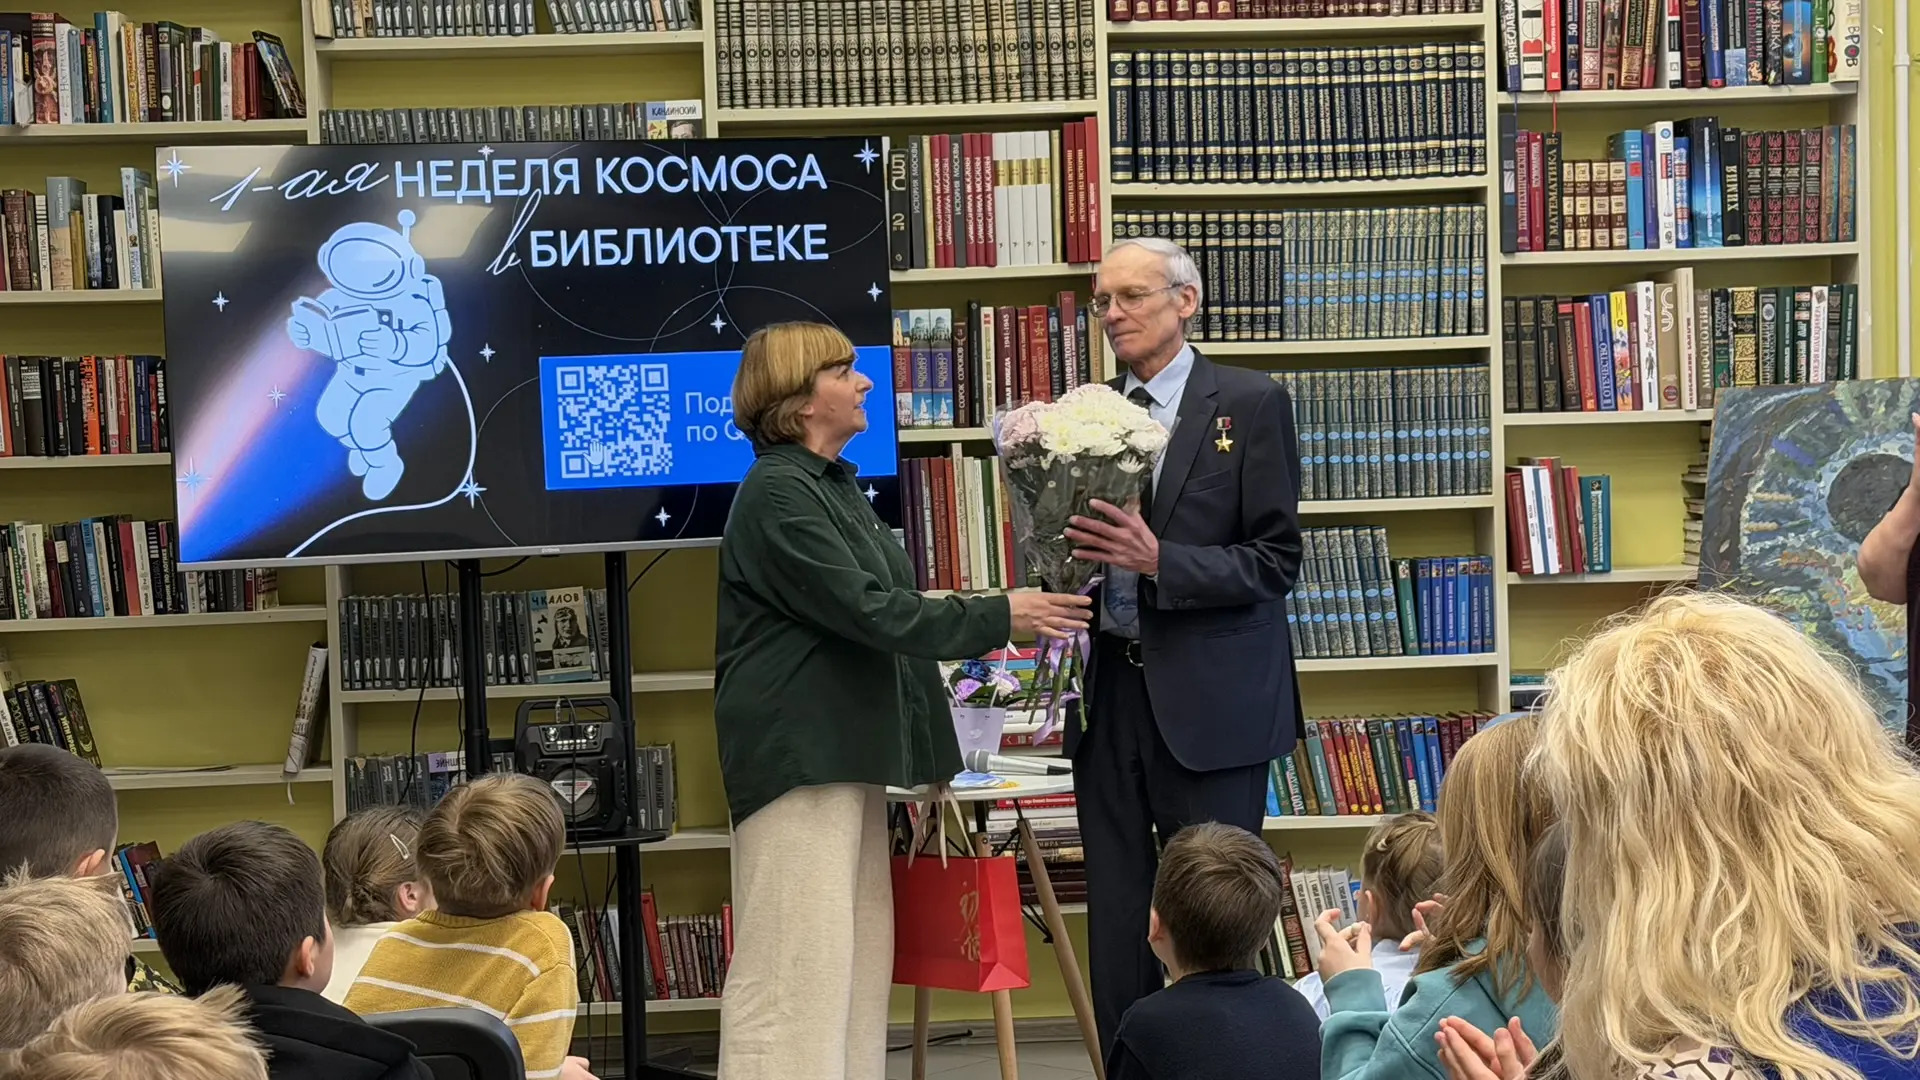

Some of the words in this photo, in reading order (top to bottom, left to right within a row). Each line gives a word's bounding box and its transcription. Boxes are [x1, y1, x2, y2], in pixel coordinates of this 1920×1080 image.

[1568, 23, 1578, 36] 50
[1769, 0, 1781, 50] МУЗЫКА
[1508, 13, 1519, 65] ВЯЧЕСЛАВ
[652, 105, 697, 116] КАНДИНСКИЙ
[911, 142, 919, 176] МОСКВЫ
[1196, 155, 1202, 163] 4
[1212, 155, 1217, 163] 5
[1227, 155, 1233, 163] 6
[1243, 155, 1249, 163] 7
[1278, 155, 1283, 163] 8
[1293, 154, 1299, 162] 9
[1309, 153, 1315, 161] 9
[1355, 153, 1364, 161] 12
[1372, 152, 1381, 160] 13
[1387, 152, 1396, 160] 14
[1401, 151, 1410, 159] 15
[1430, 149, 1439, 157] 17
[1445, 149, 1454, 157] 18
[1460, 148, 1468, 156] 19
[1475, 148, 1484, 156] 20
[952, 143, 960, 177] МОСКВЫ
[395, 158, 580, 203] НЕДЕЛЯ
[597, 154, 827, 194] КОСМОСА
[984, 156, 992, 191] МОСКВЫ
[1516, 147, 1528, 230] ПОЛИТЕХНИЧЕСКИЙ
[1548, 149, 1559, 235] МАТЕМАТИКА
[1726, 165, 1739, 212] ХИМИЯ
[912, 179, 921, 214] ИСТОРИЯ
[954, 180, 962, 215] ИСТОРИЯ
[486, 189, 541, 275] в
[531, 224, 829, 267] БИБЛИОТЕКЕ
[40, 233, 49, 272] ЭСТЕТИКА
[1699, 306, 1711, 389] МИФОЛОГИЯ
[955, 347, 965, 380] СОРОКОВ
[1599, 343, 1611, 397] ОТЕЧЕСТВО
[956, 383, 966, 408] СОРОК
[531, 593, 580, 606] ЧКАЛОВ
[1292, 795, 1304, 811] 100
